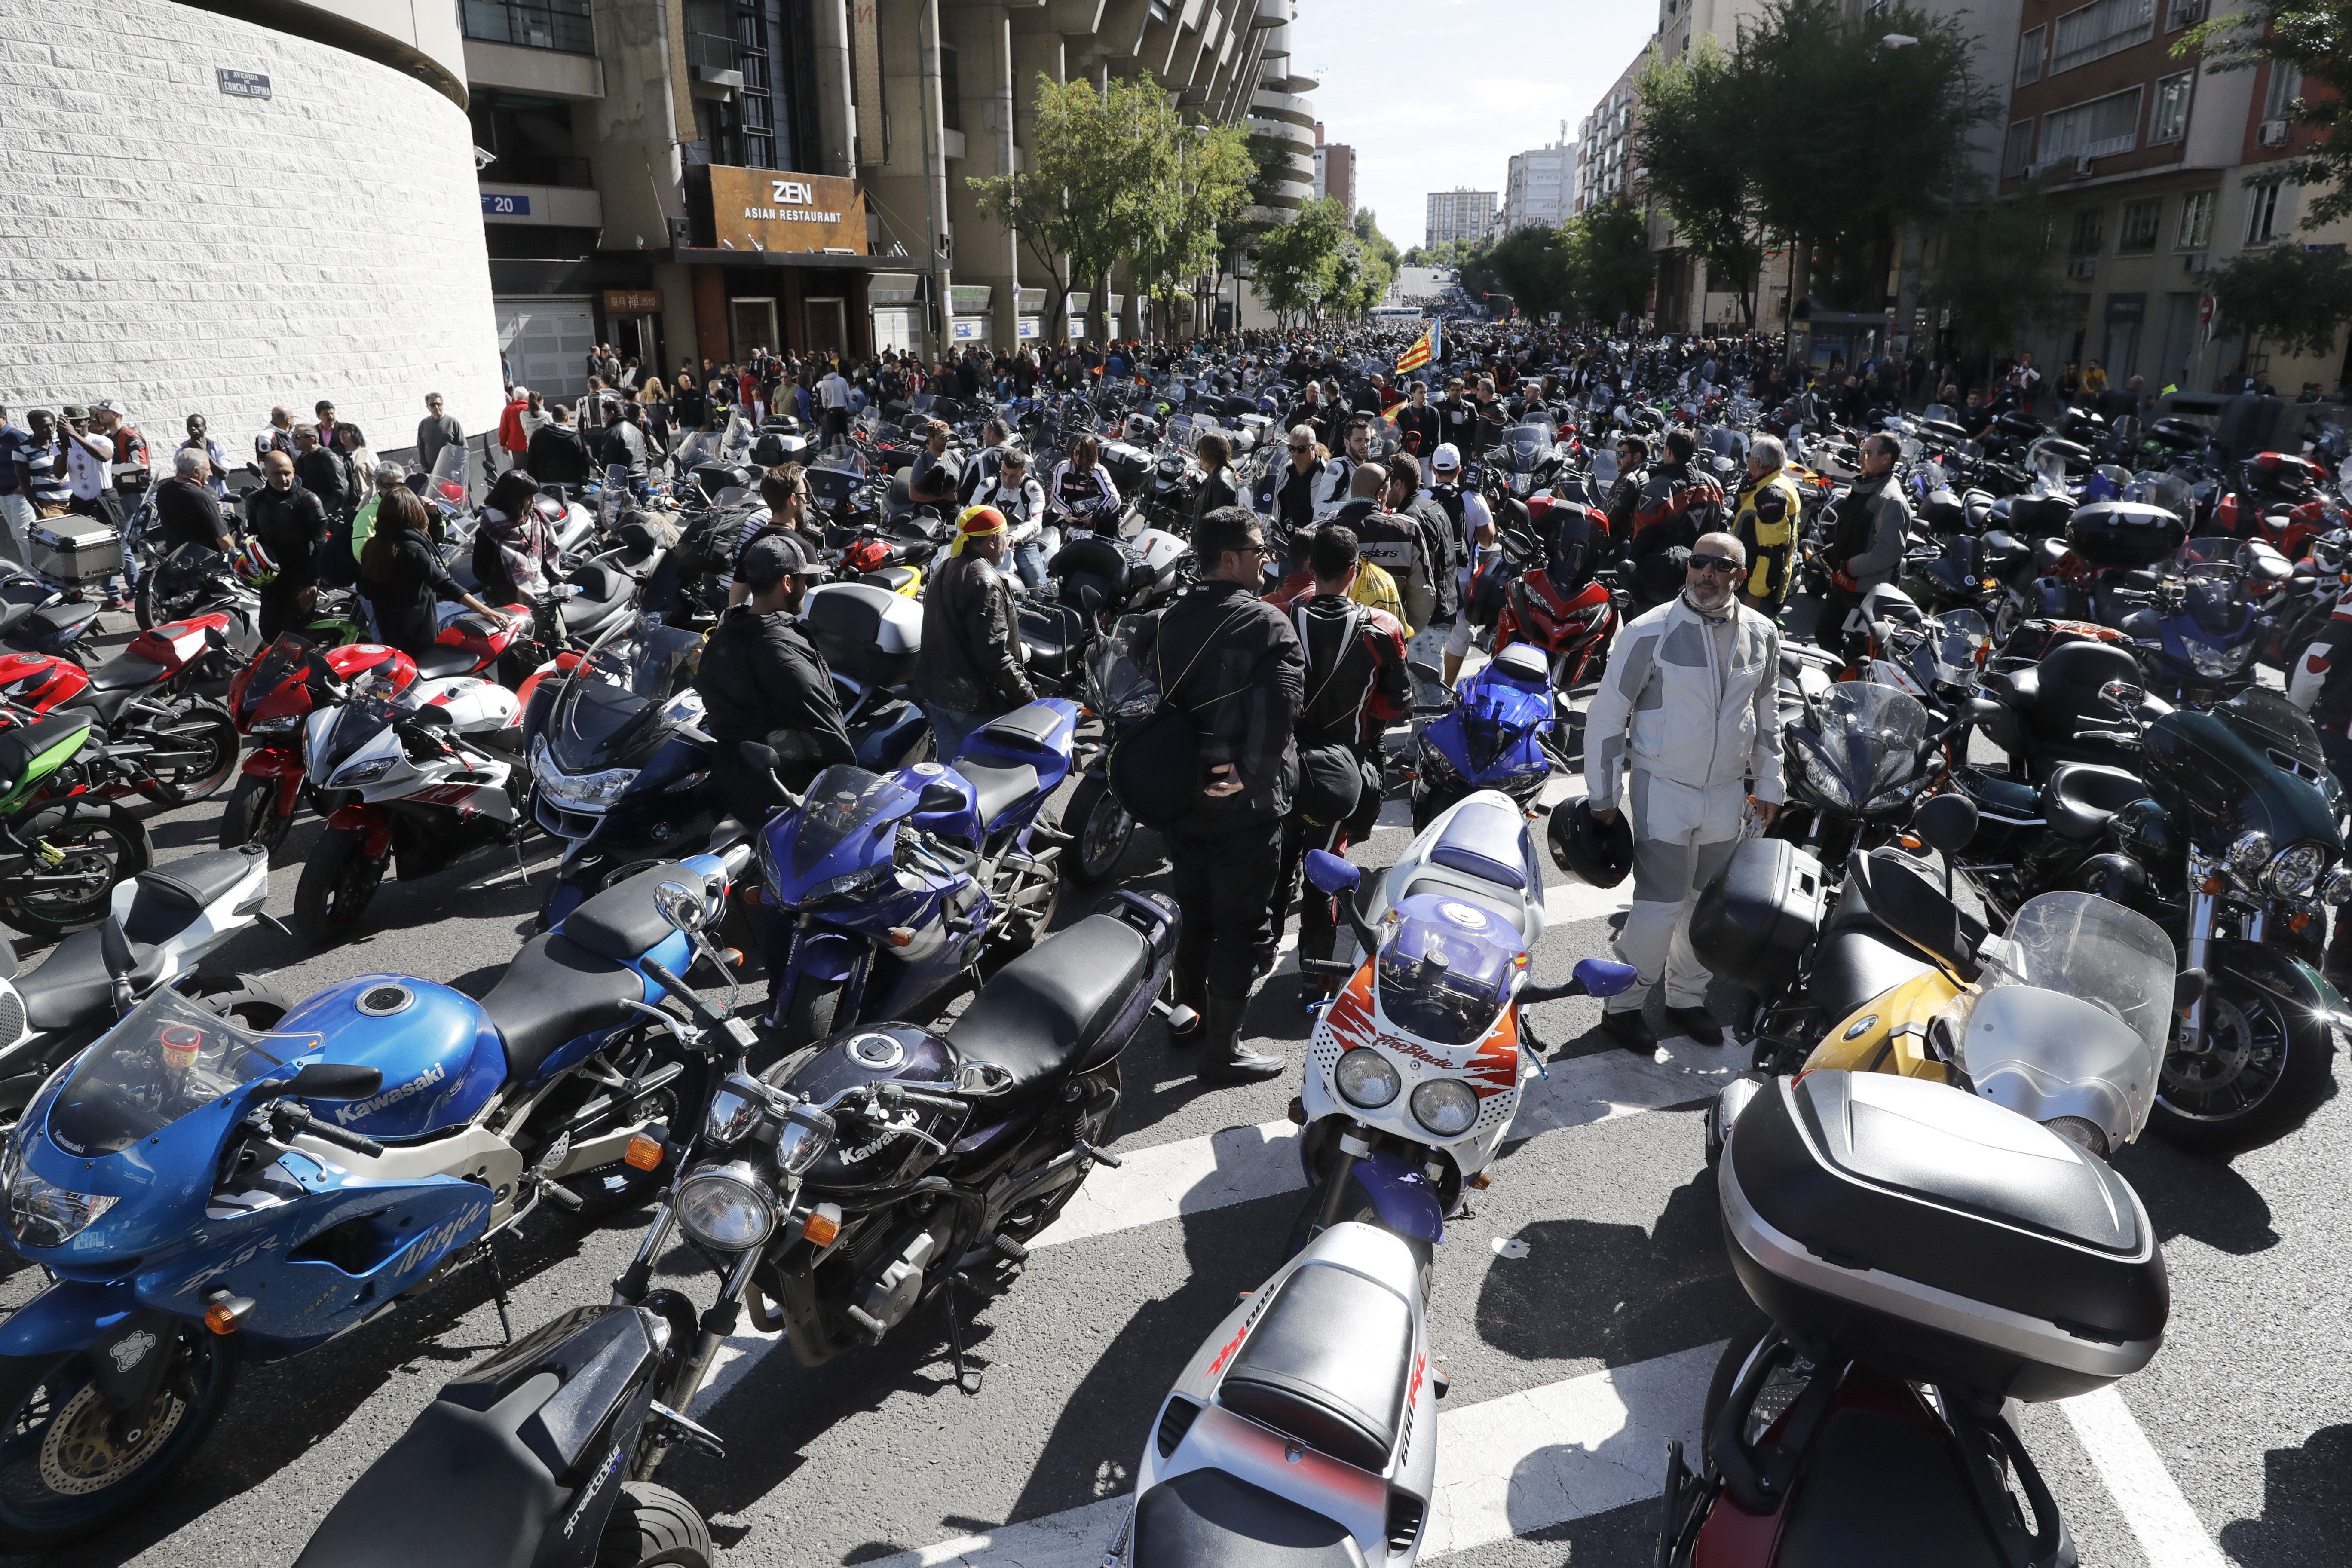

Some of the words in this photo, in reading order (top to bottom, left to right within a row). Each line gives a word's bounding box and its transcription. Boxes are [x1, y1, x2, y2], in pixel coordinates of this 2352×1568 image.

[233, 71, 259, 81] AVENIDA
[224, 81, 248, 93] CONCHA
[251, 85, 271, 96] ESPINA
[495, 197, 514, 212] 20
[772, 181, 812, 205] ZEN
[745, 208, 776, 220] ASIAN
[779, 209, 842, 223] RESTAURANT
[1358, 549, 1399, 557] estars
[787, 934, 799, 965] YAMAHA
[1372, 1032, 1462, 1070] FireBlade
[337, 1062, 446, 1126] Kawasaki
[54, 1129, 86, 1154] Kawasaki
[839, 1109, 921, 1167] Kawasaki
[395, 1201, 487, 1278] Ninja
[173, 1234, 281, 1297] ZX-9R
[609, 1452, 624, 1474] 675
